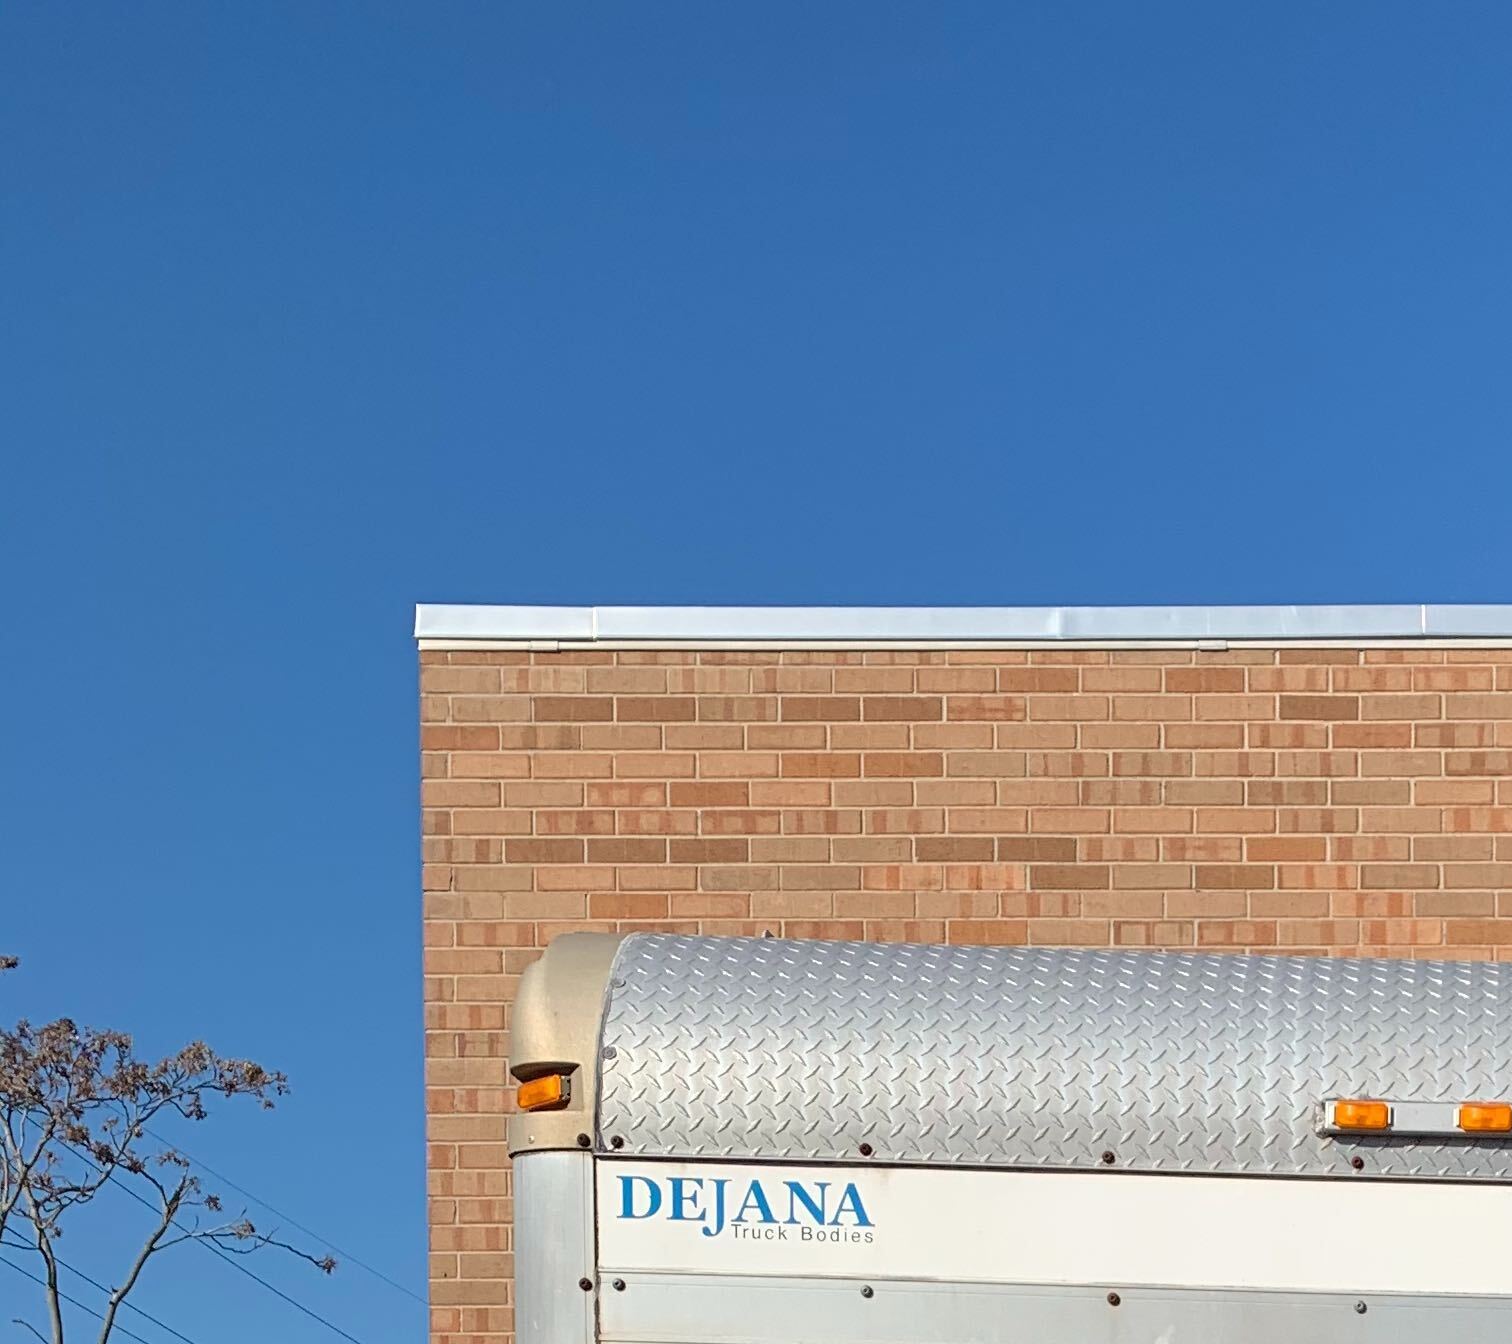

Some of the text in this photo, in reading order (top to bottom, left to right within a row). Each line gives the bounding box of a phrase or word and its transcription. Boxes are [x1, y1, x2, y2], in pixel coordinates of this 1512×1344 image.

[615, 1175, 875, 1237] DEJANA
[731, 1223, 874, 1244] Truck Bodies
